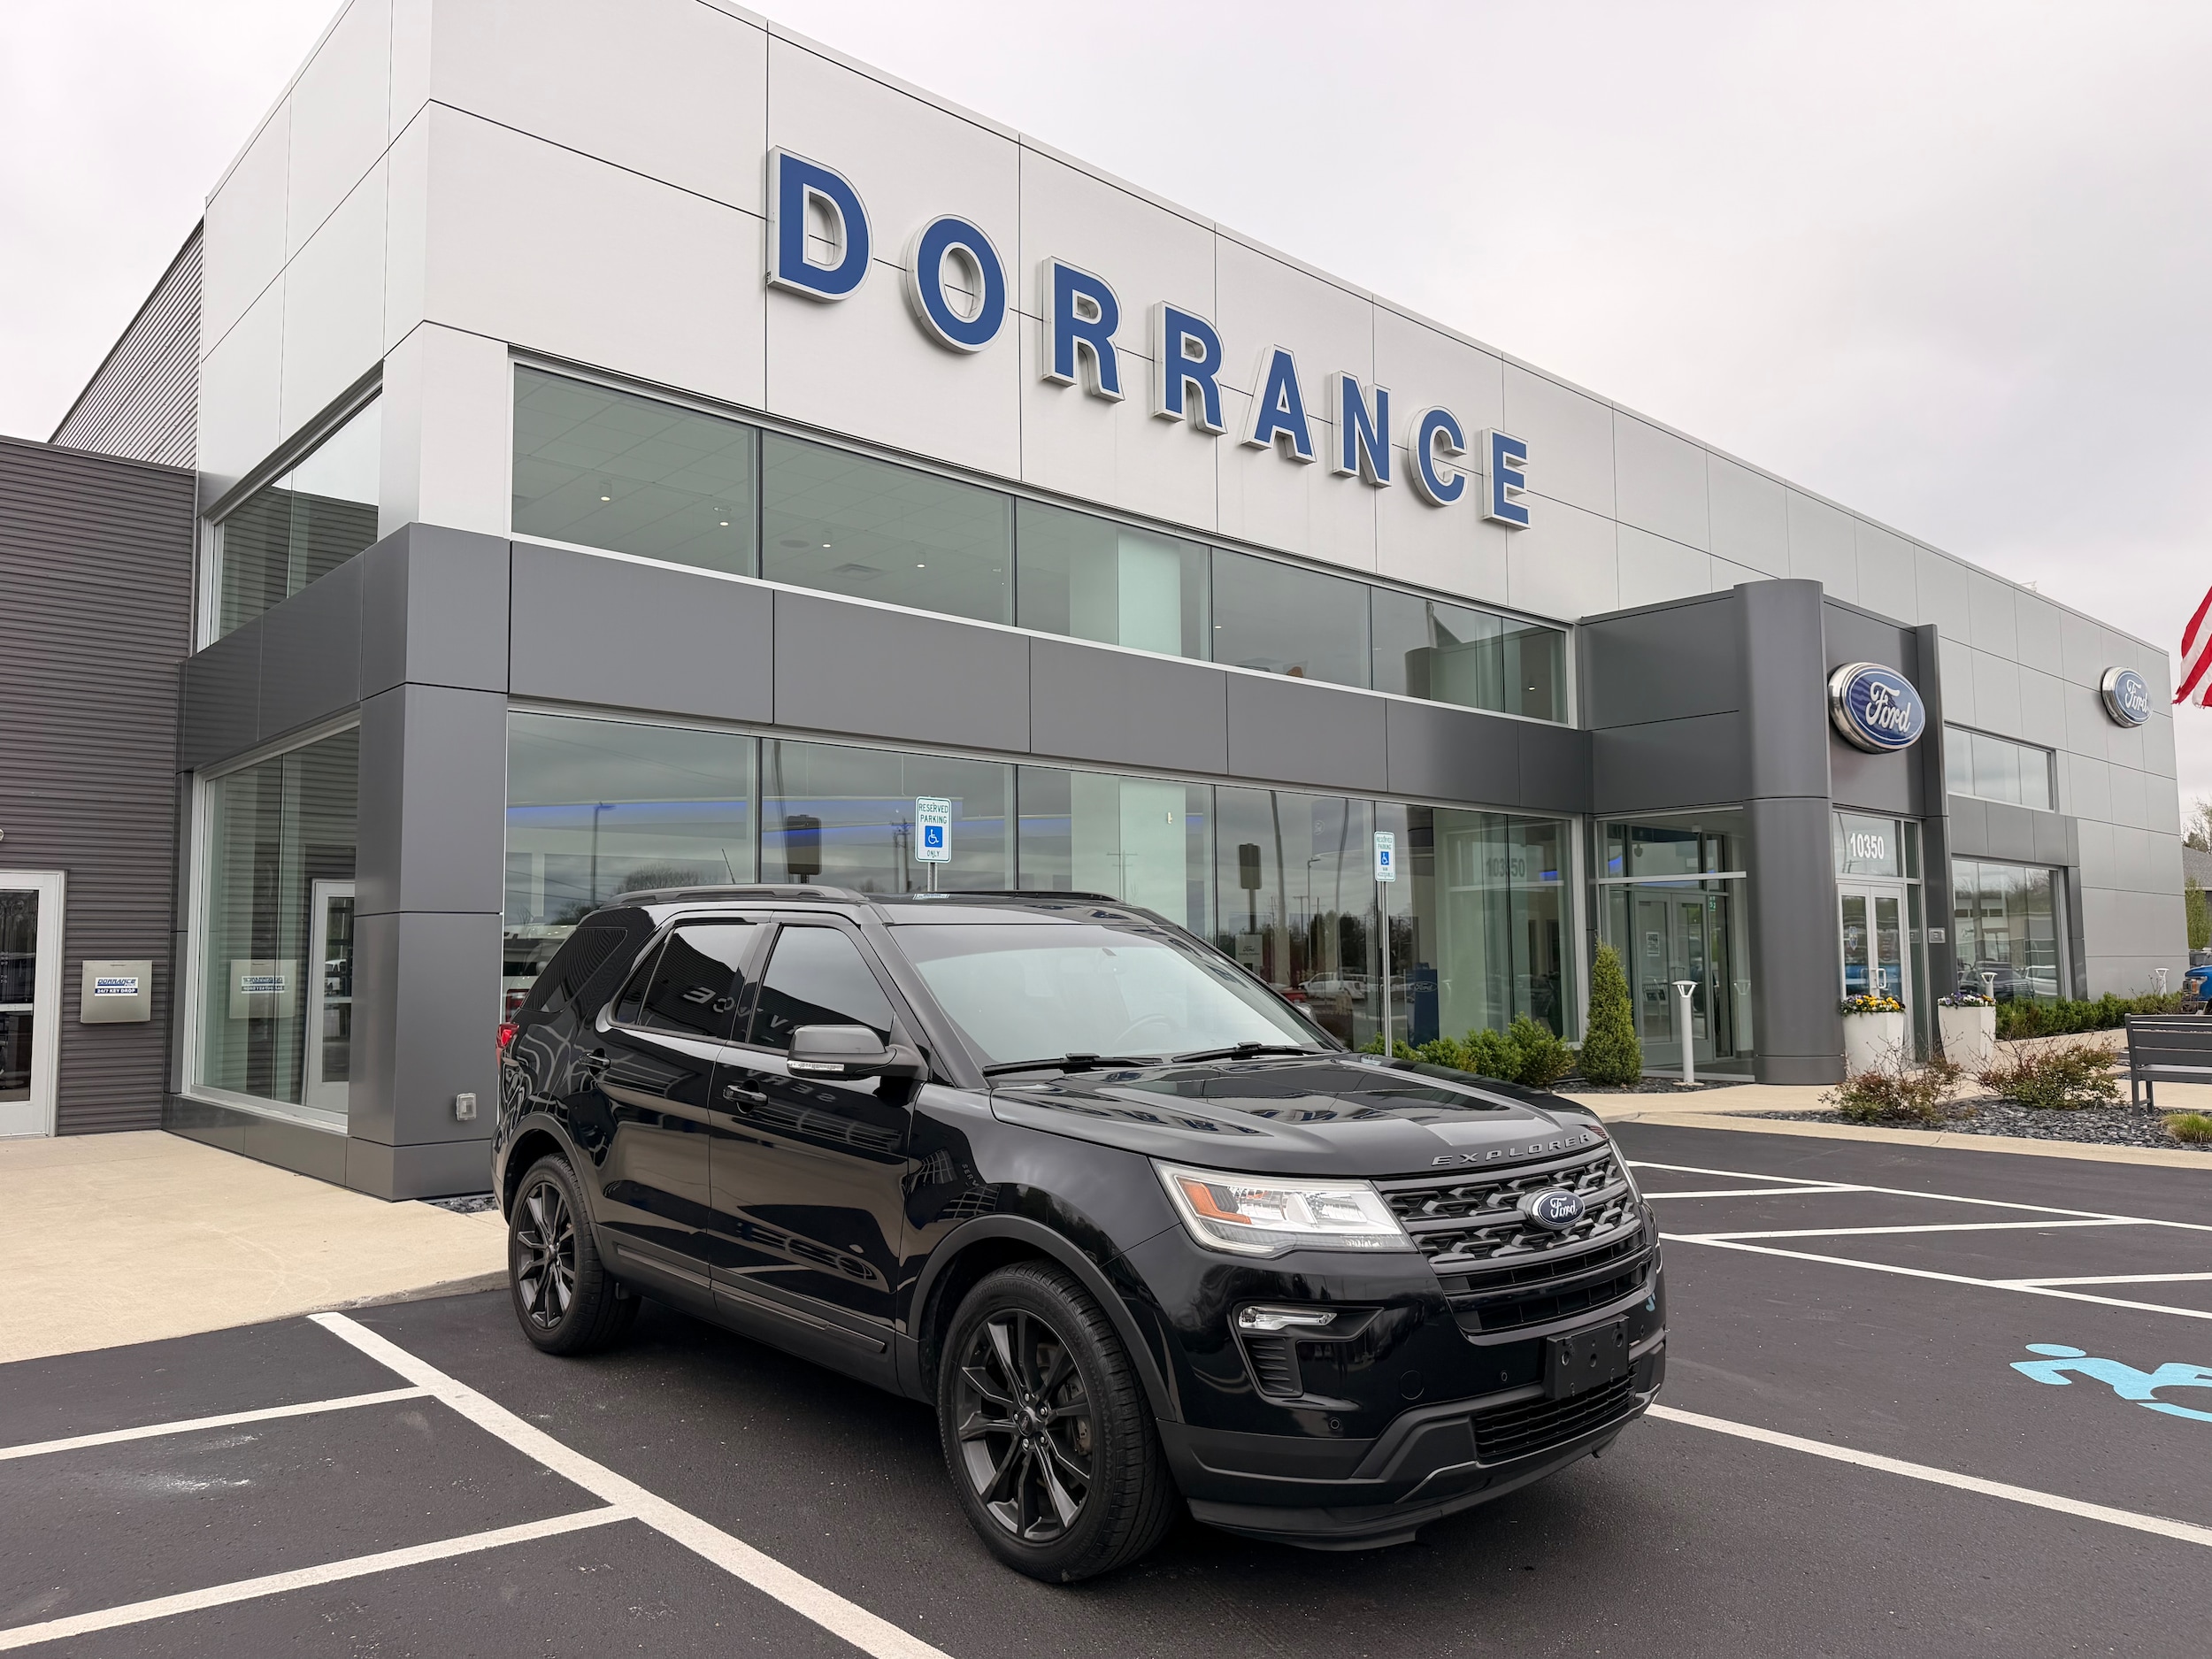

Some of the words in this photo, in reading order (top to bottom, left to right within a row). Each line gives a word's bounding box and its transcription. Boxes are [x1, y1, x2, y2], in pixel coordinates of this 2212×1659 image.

[768, 144, 1532, 531] DORRANCE
[1865, 681, 1911, 733] Ford
[2124, 679, 2150, 714] Ford
[918, 803, 949, 814] RESERVED
[920, 814, 948, 825] PARKING
[1850, 833, 1885, 860] 10350
[1431, 1133, 1591, 1167] EXPLORER
[1549, 1196, 1578, 1219] Ford
